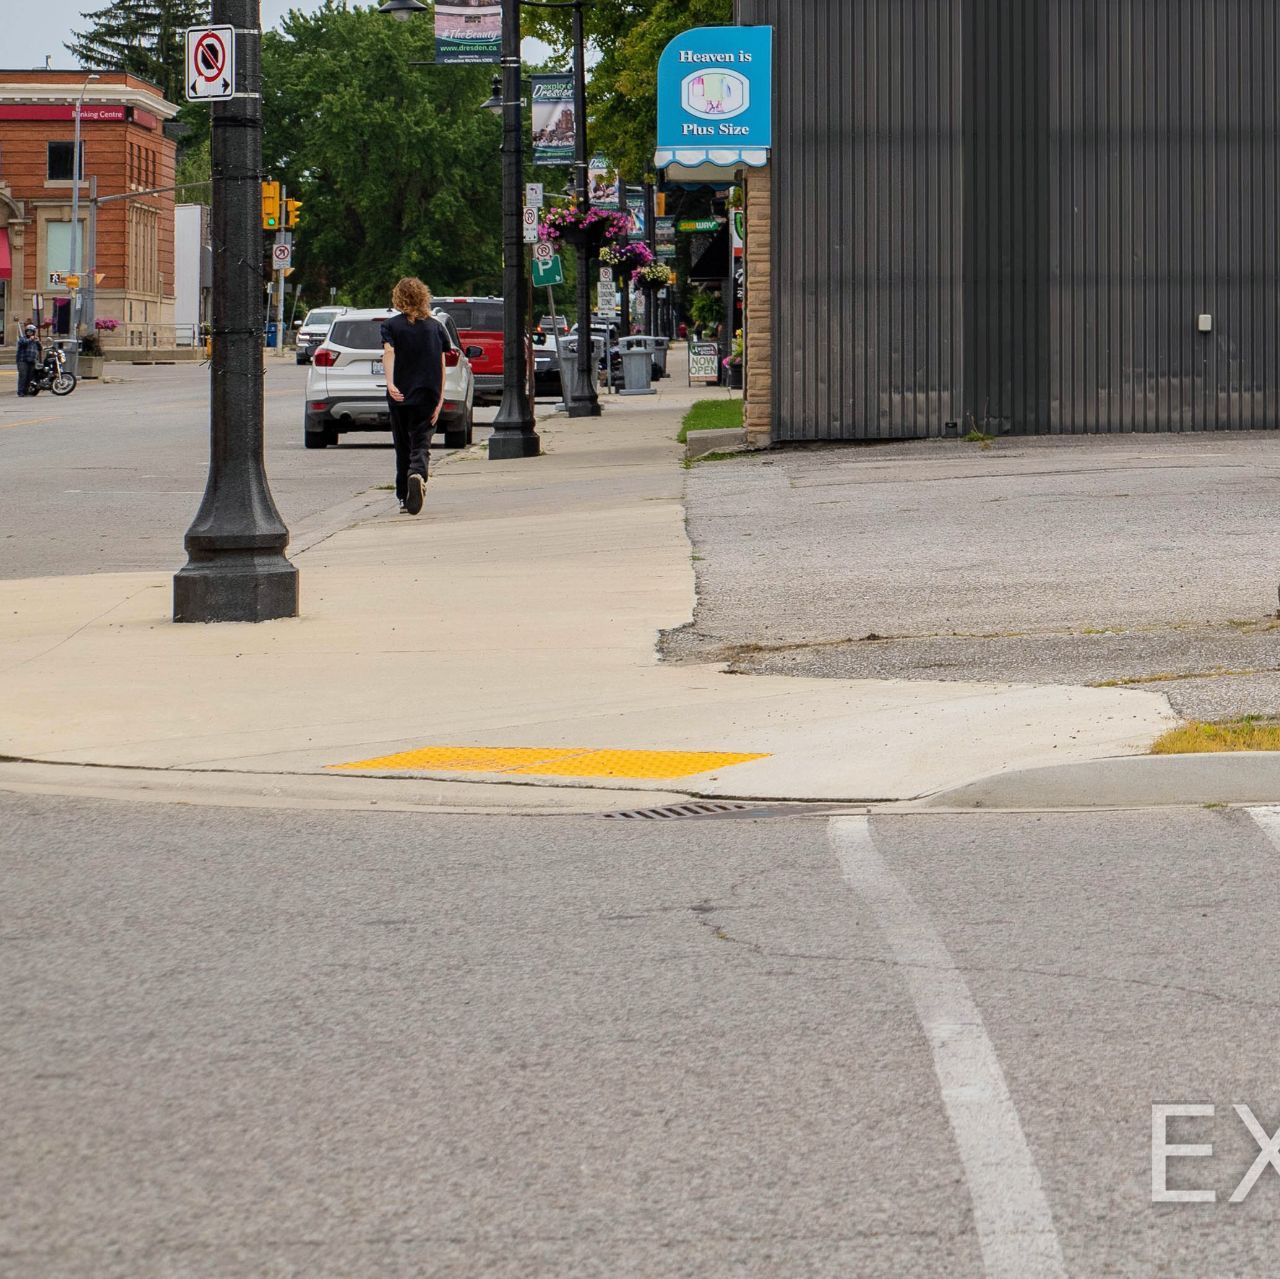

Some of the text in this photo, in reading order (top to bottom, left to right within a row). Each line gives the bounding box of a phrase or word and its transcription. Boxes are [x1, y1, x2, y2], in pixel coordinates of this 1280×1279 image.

[679, 50, 752, 63] Heaven is
[72, 111, 98, 119] Bnking
[682, 124, 749, 135] Plus Size
[692, 357, 715, 366] NOW
[690, 366, 717, 375] OPEN
